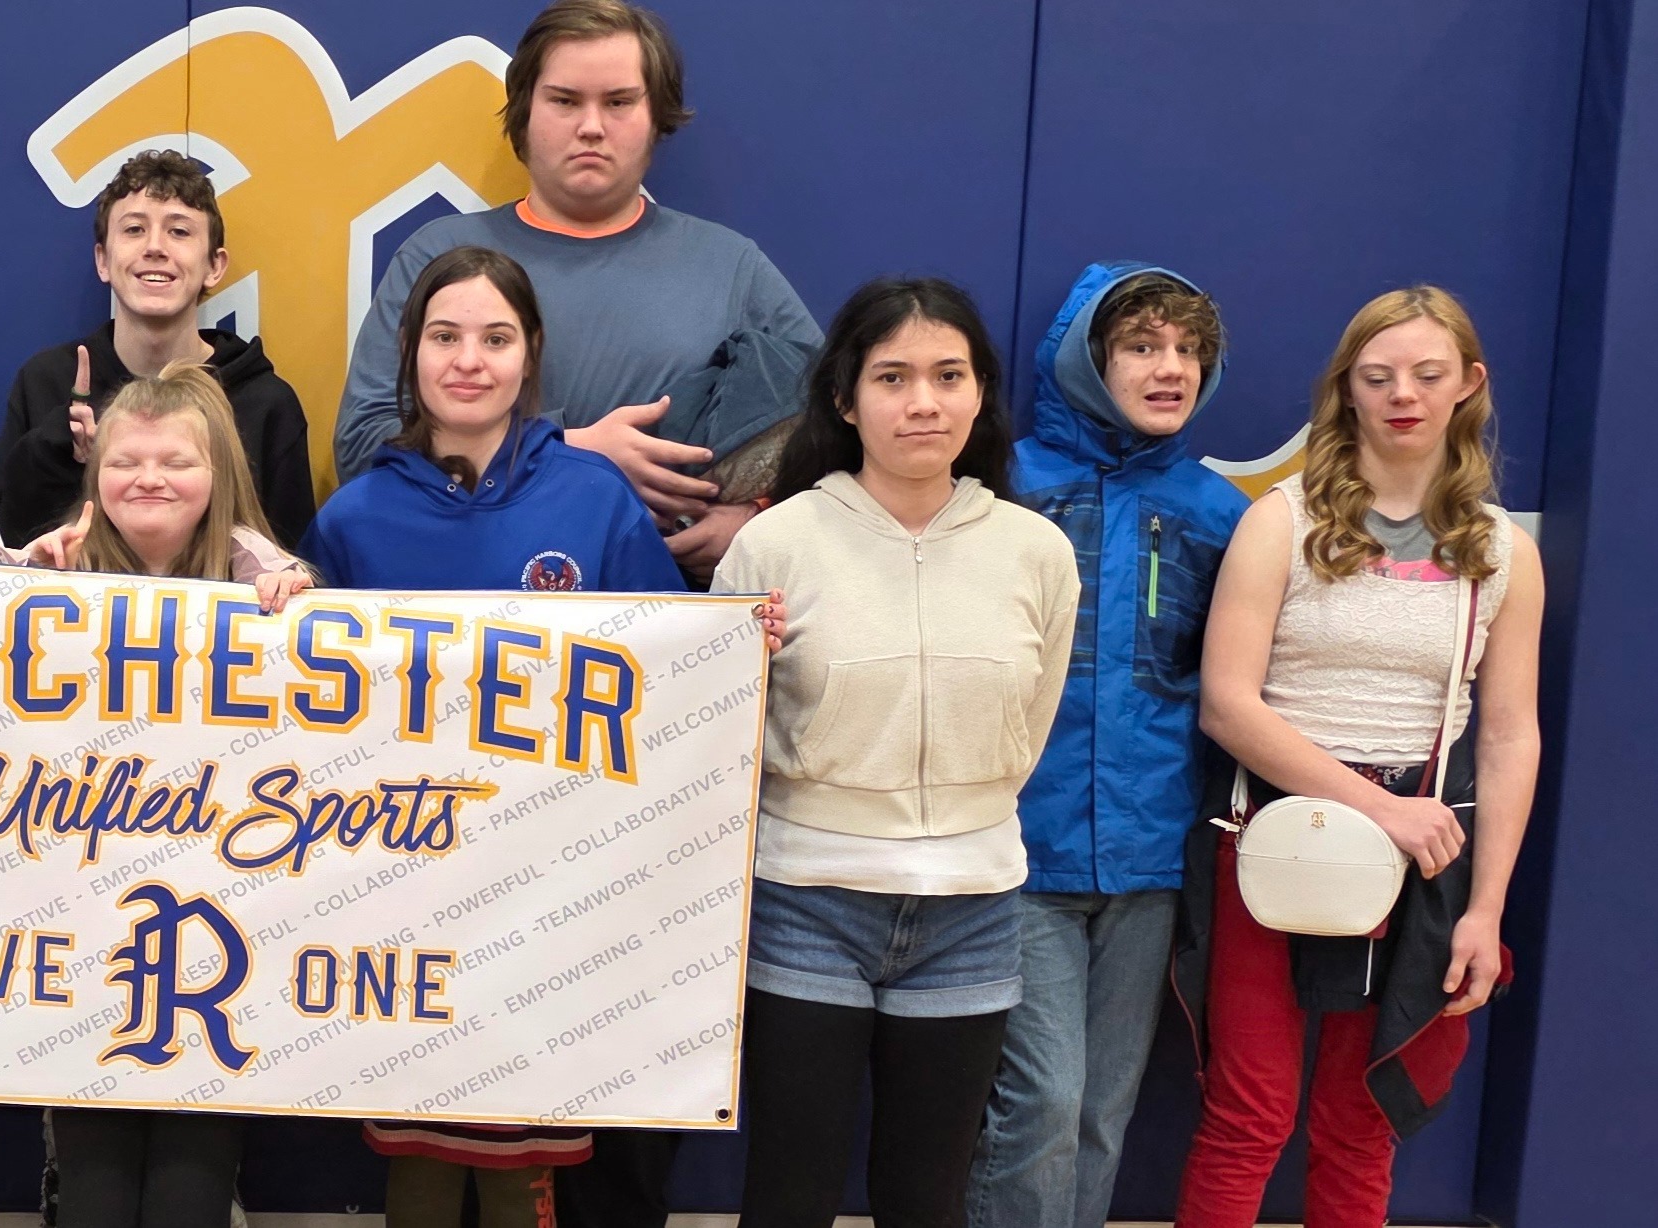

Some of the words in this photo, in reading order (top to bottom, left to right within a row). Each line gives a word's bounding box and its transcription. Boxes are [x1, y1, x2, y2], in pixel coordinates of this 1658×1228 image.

[212, 760, 500, 876] Sports
[432, 860, 545, 930] POWERFUL
[559, 767, 726, 865] COLLABORATIVE
[292, 944, 456, 1024] ONE
[358, 1011, 485, 1088] SUPPORTIVE
[503, 931, 644, 1015] EMPOWERING
[544, 985, 657, 1055] POWERFUL
